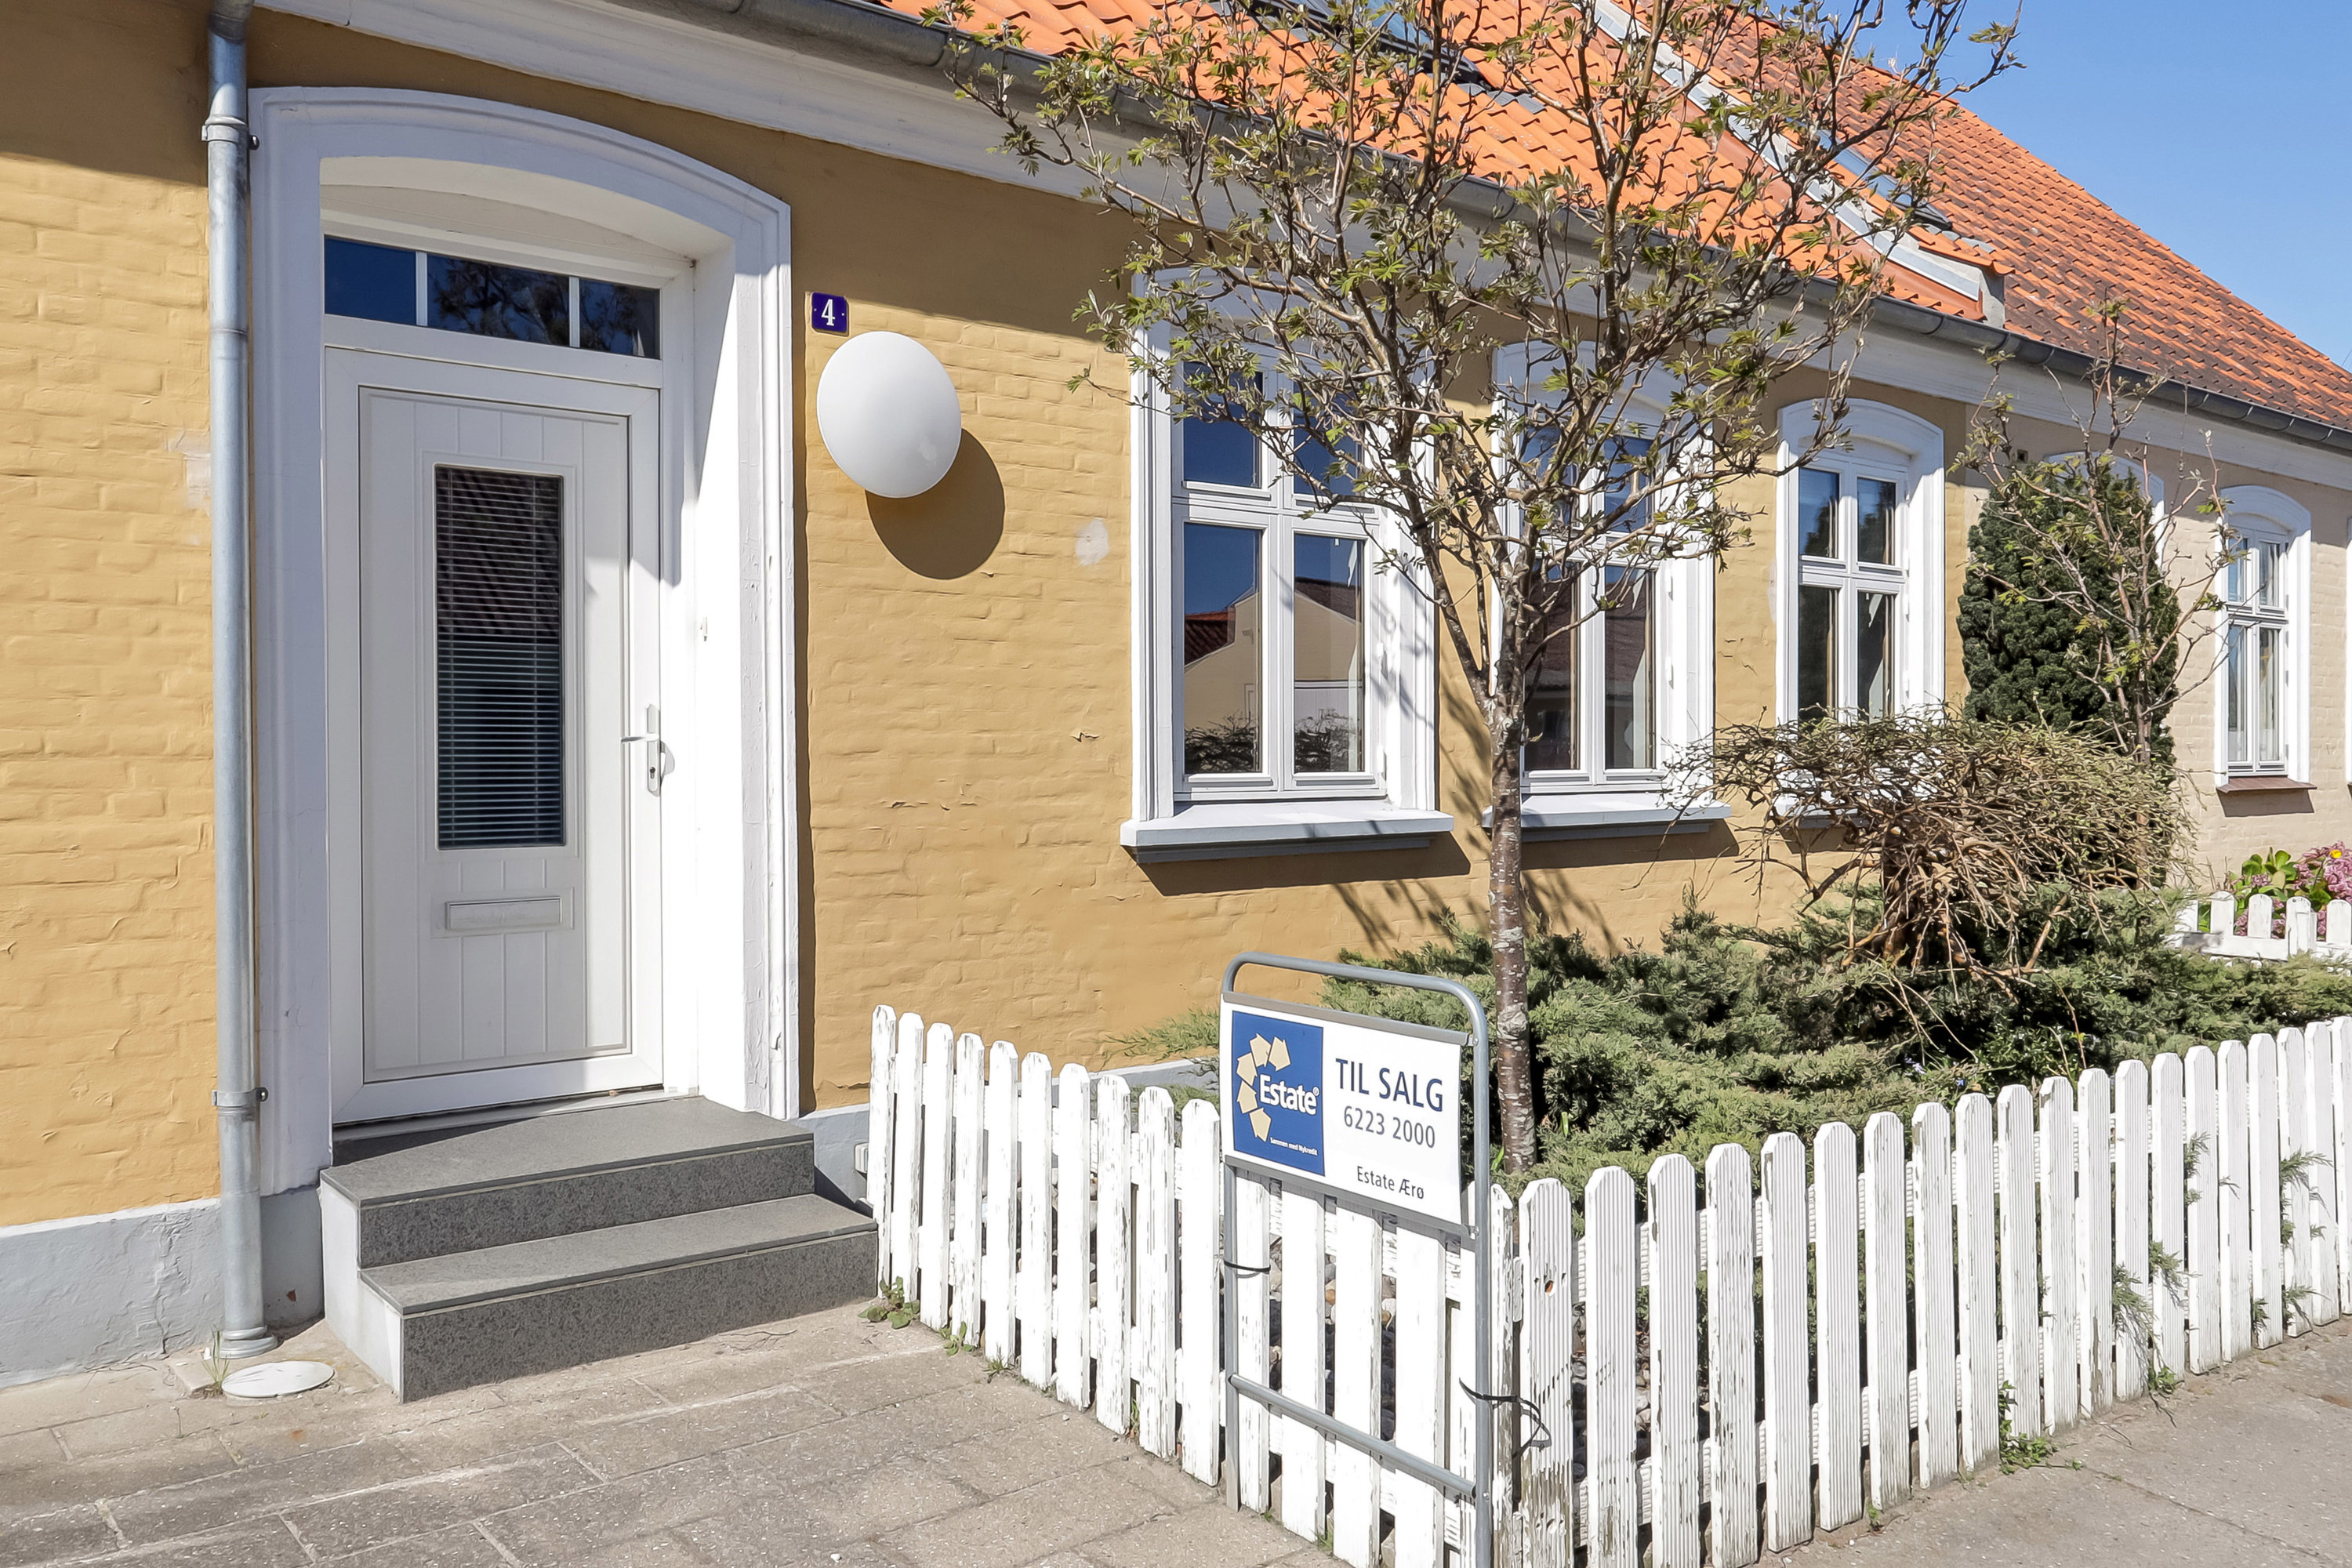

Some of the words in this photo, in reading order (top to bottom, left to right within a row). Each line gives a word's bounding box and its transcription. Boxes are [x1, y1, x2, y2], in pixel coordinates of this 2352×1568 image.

[821, 299, 836, 326] 4
[1335, 1058, 1370, 1095] TIL
[1378, 1067, 1443, 1112] SALG
[1344, 1105, 1385, 1135] 6223
[1392, 1116, 1436, 1149] 2000
[1357, 1166, 1395, 1191] Estate
[1399, 1178, 1425, 1200] Ærø
